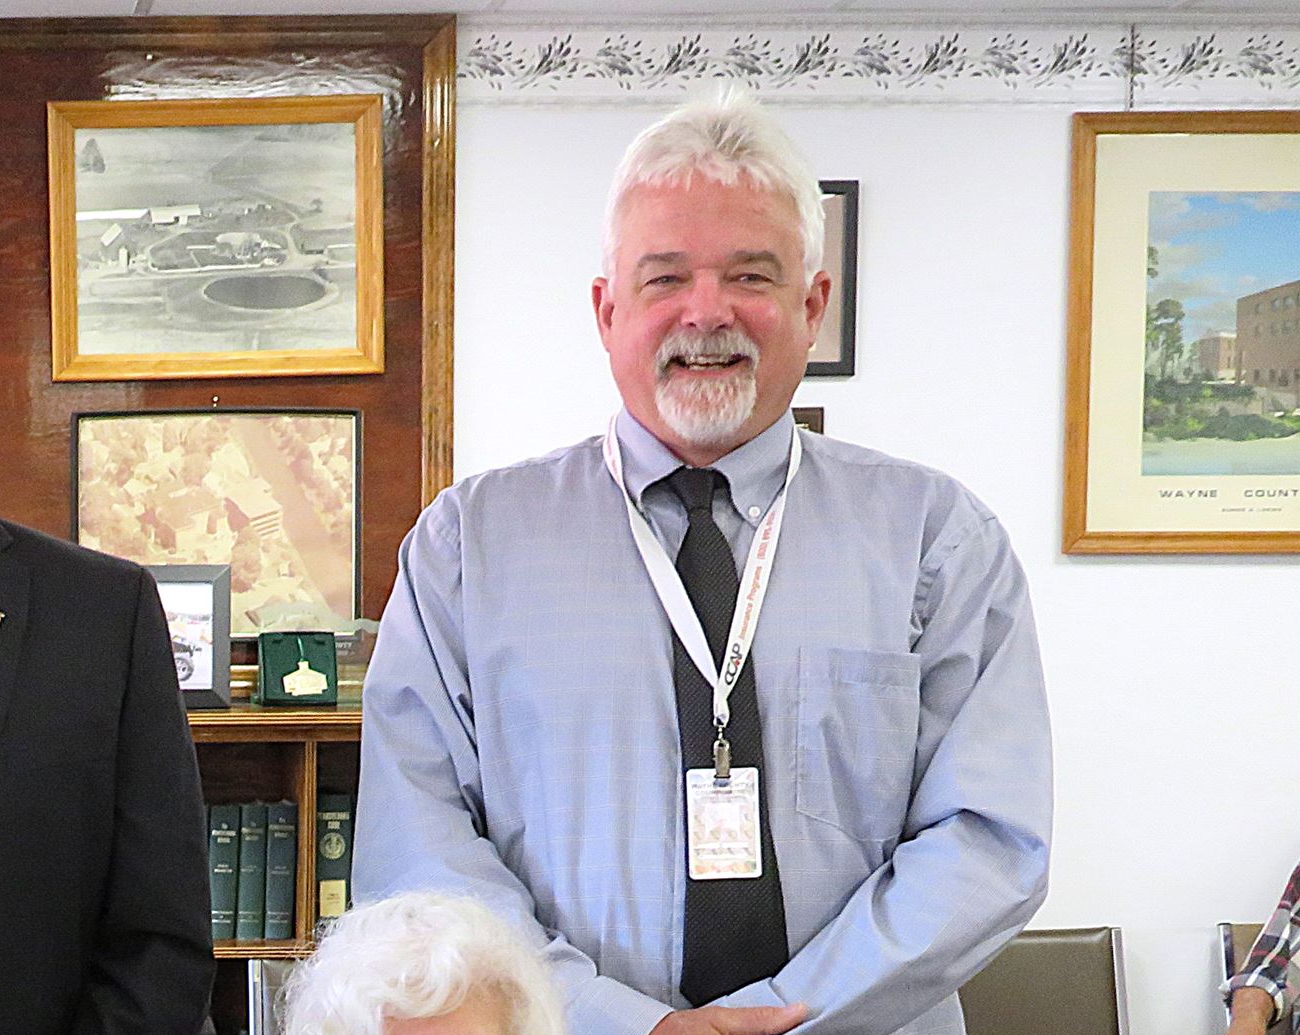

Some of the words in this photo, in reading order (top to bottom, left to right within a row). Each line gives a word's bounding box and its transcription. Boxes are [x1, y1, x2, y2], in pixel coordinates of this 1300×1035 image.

[1159, 489, 1218, 499] WAYNE
[724, 643, 743, 687] CCAP
[738, 603, 753, 641] Insurance
[747, 565, 763, 602] Programs
